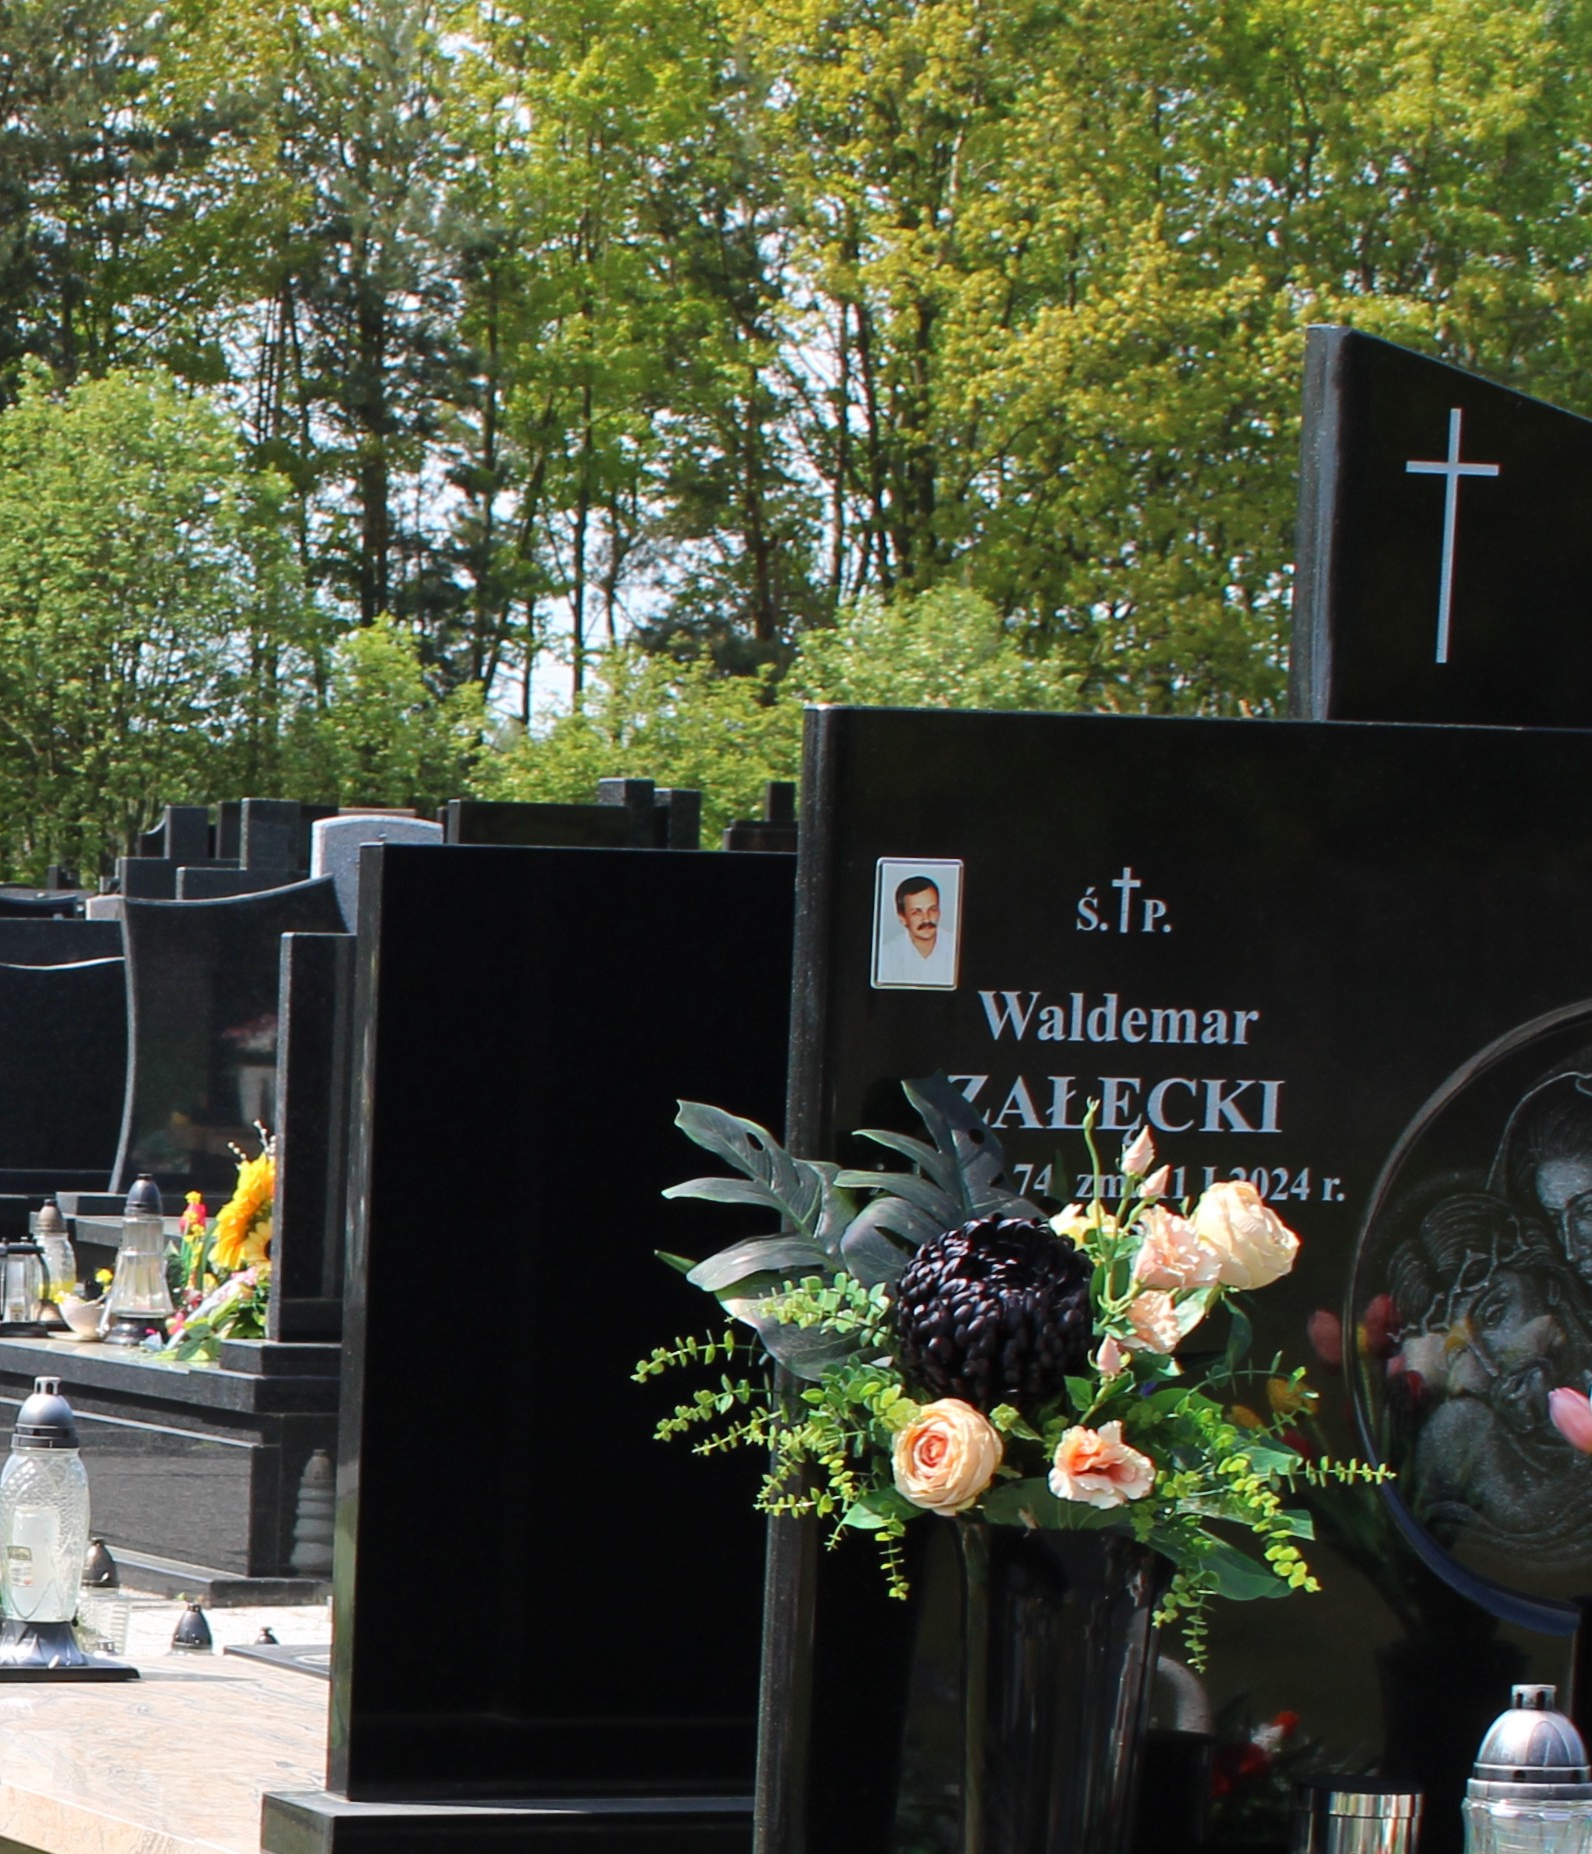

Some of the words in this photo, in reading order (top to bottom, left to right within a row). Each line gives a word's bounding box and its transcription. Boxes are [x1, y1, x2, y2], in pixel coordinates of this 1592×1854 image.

[977, 990, 1260, 1046] Waldemar
[946, 1074, 1286, 1146] ZAŁĘCKI
[1014, 1163, 1054, 1197] 74
[1323, 1178, 1346, 1201] r.
